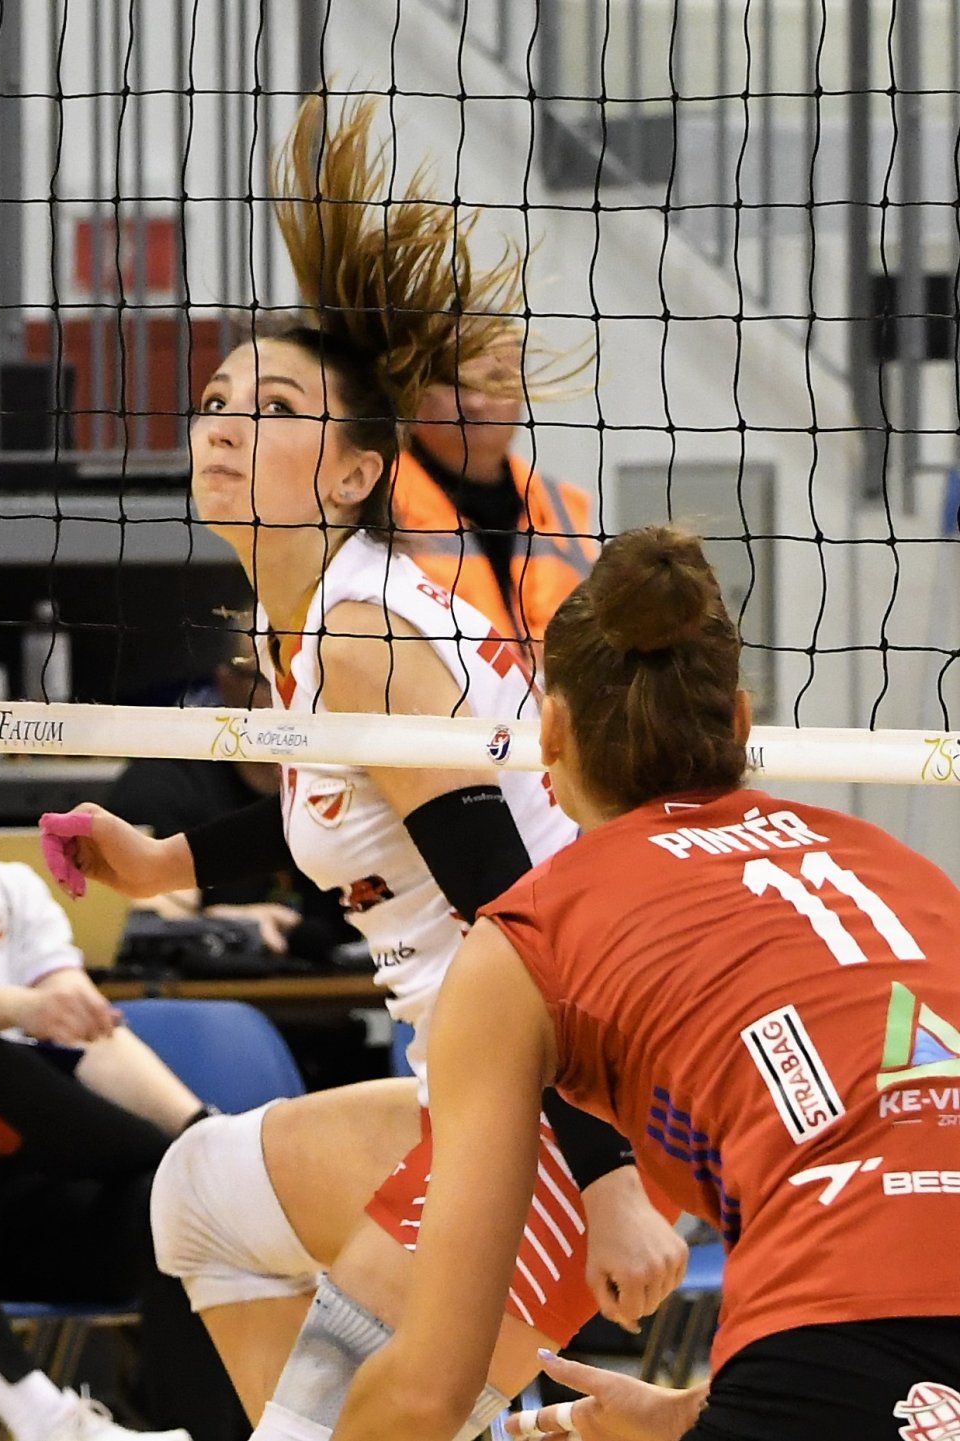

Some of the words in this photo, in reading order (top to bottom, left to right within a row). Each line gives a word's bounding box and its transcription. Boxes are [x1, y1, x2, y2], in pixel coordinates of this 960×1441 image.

[648, 807, 830, 859] PINTÉR
[742, 851, 927, 966] 11
[762, 1021, 827, 1127] STRABAG
